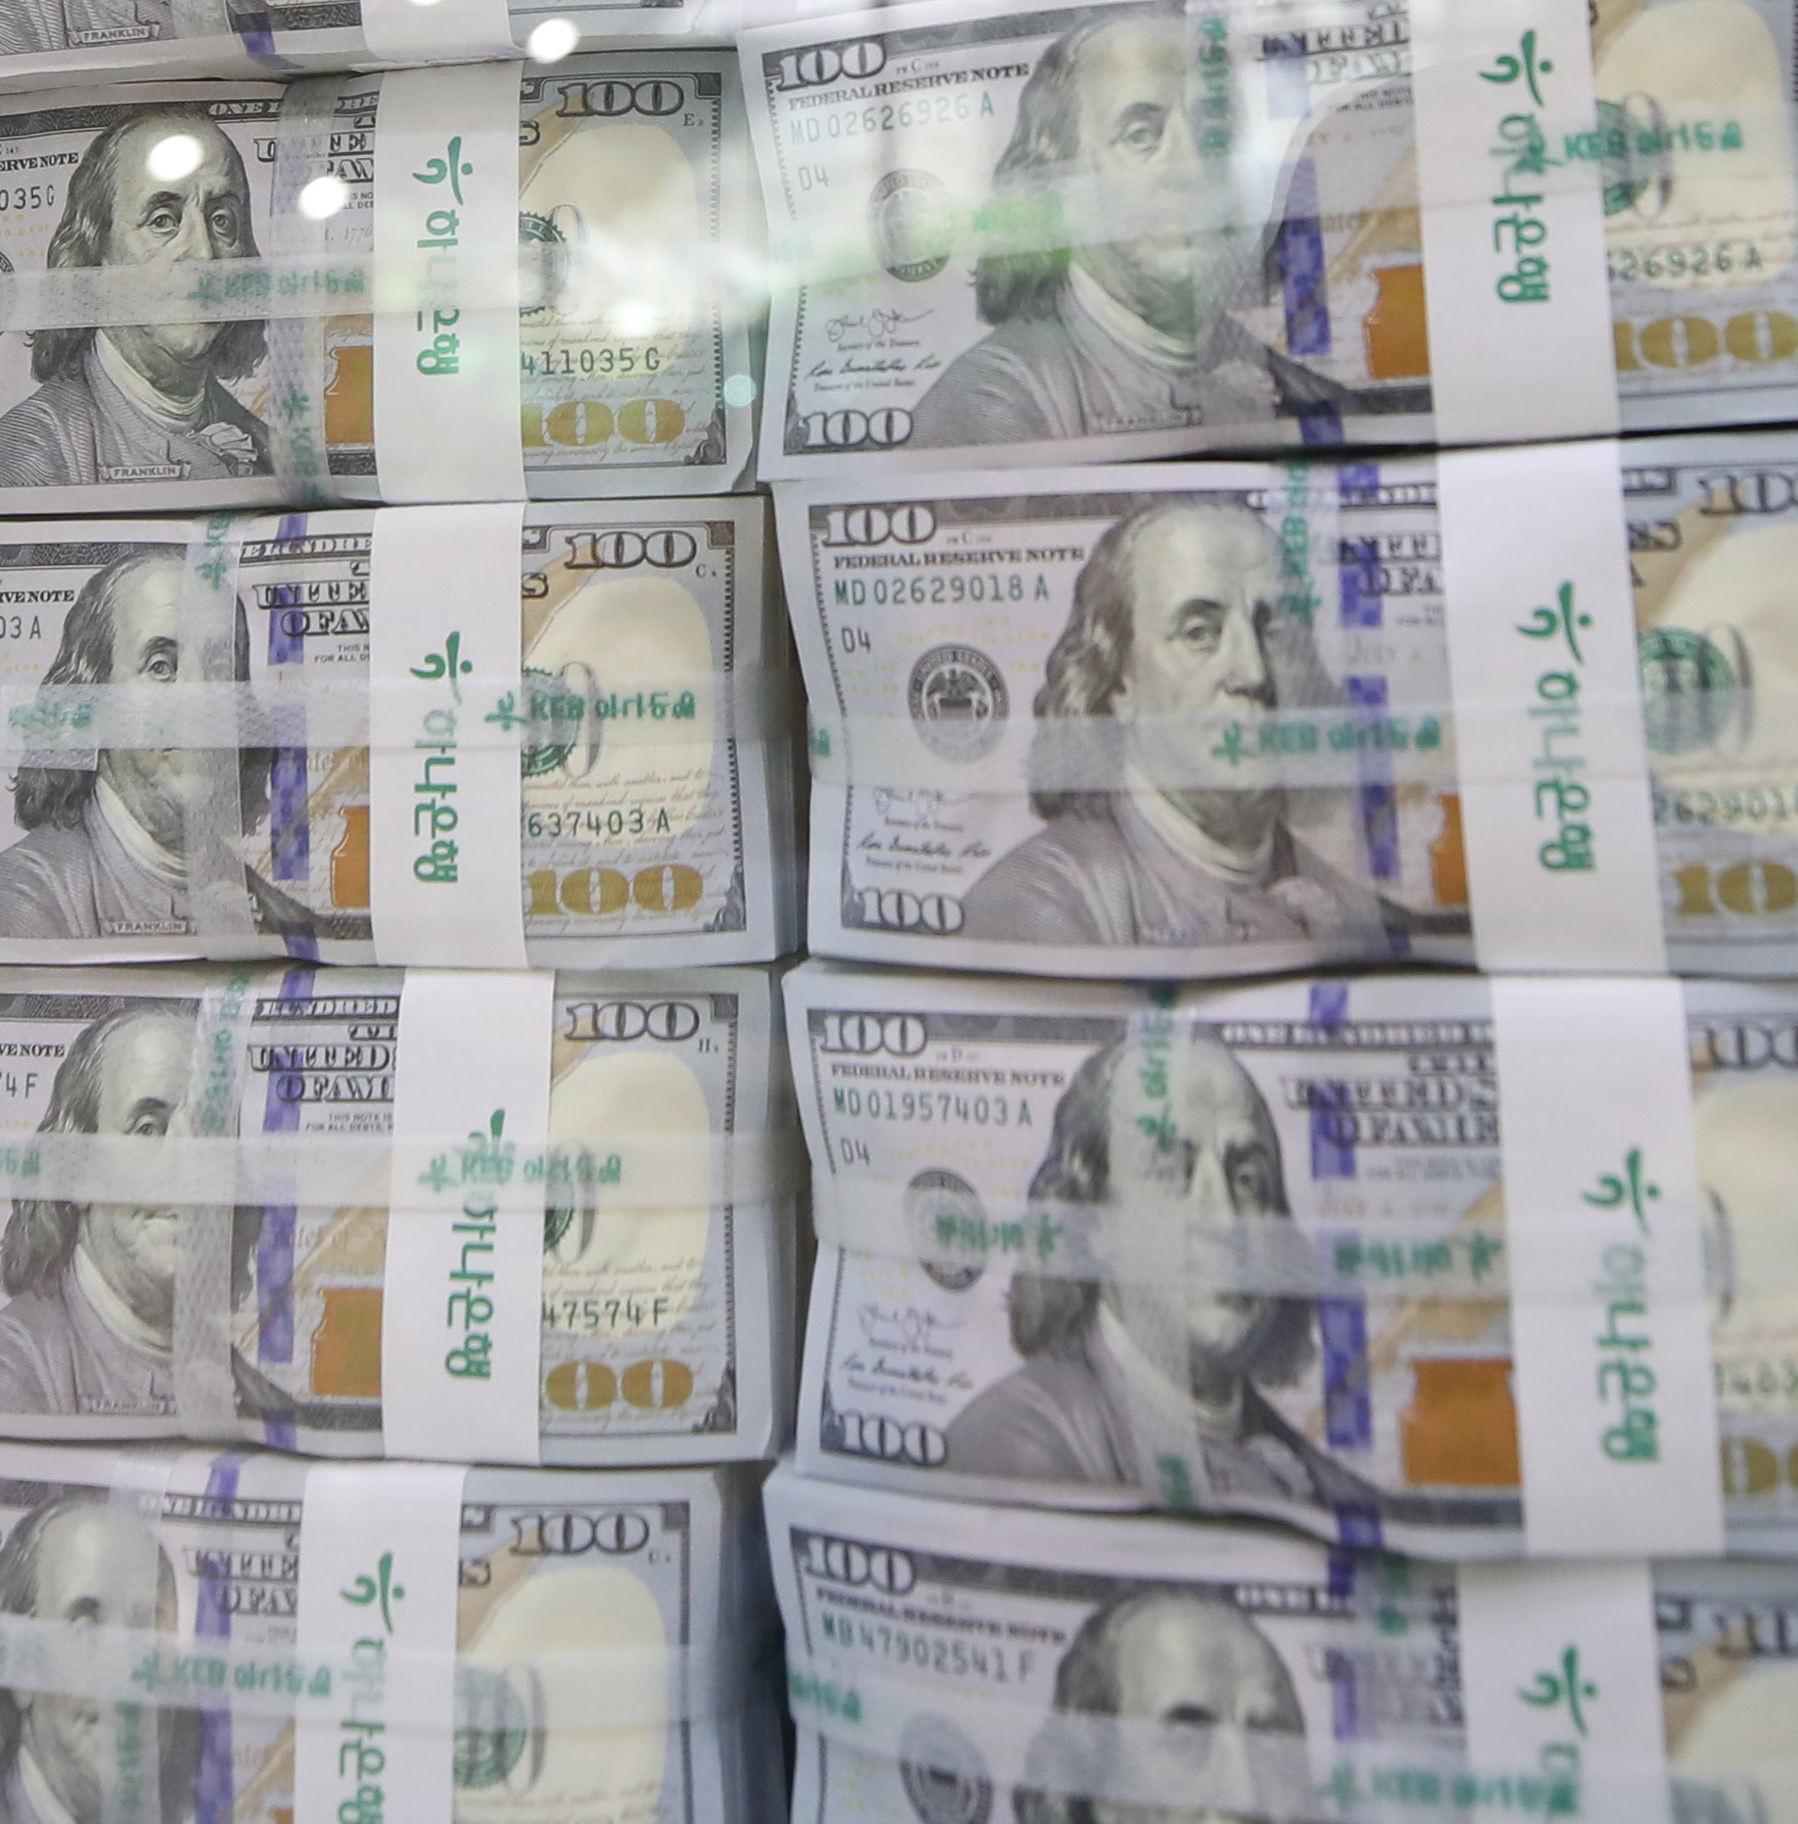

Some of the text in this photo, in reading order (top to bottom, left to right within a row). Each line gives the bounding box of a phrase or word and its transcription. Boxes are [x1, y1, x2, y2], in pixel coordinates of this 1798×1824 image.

[83, 26, 146, 41] FRANKLIN
[776, 40, 887, 92] 100
[557, 81, 684, 116] 100
[789, 63, 1029, 111] FEDERAL RESERVE NOTE
[791, 99, 969, 145] MD 02626926
[39, 152, 79, 167] NOTE
[803, 407, 913, 446] 100
[113, 464, 177, 477] FRANKLIN
[822, 505, 937, 547] 100
[564, 531, 697, 568] 100
[833, 546, 1085, 569] FEDERAL RESERVE NOTE
[27, 589, 75, 602] NOTE
[835, 574, 1024, 607] MD 02629018
[1528, 671, 1596, 872] 하나은행
[413, 709, 458, 883] 하나은행
[526, 812, 644, 837] 637403
[523, 866, 702, 915] 100
[116, 922, 182, 932] FRANKLIN
[860, 889, 965, 935] 100
[564, 1002, 700, 1041] 100
[820, 1015, 926, 1056] 100
[19, 1044, 64, 1057] NOTE
[248, 1046, 390, 1071] UNITED
[834, 1086, 1009, 1126] MD 01957403
[542, 1299, 643, 1329] 47574
[838, 1413, 949, 1468] 100
[509, 1513, 649, 1555] 100
[804, 1535, 917, 1596] 100
